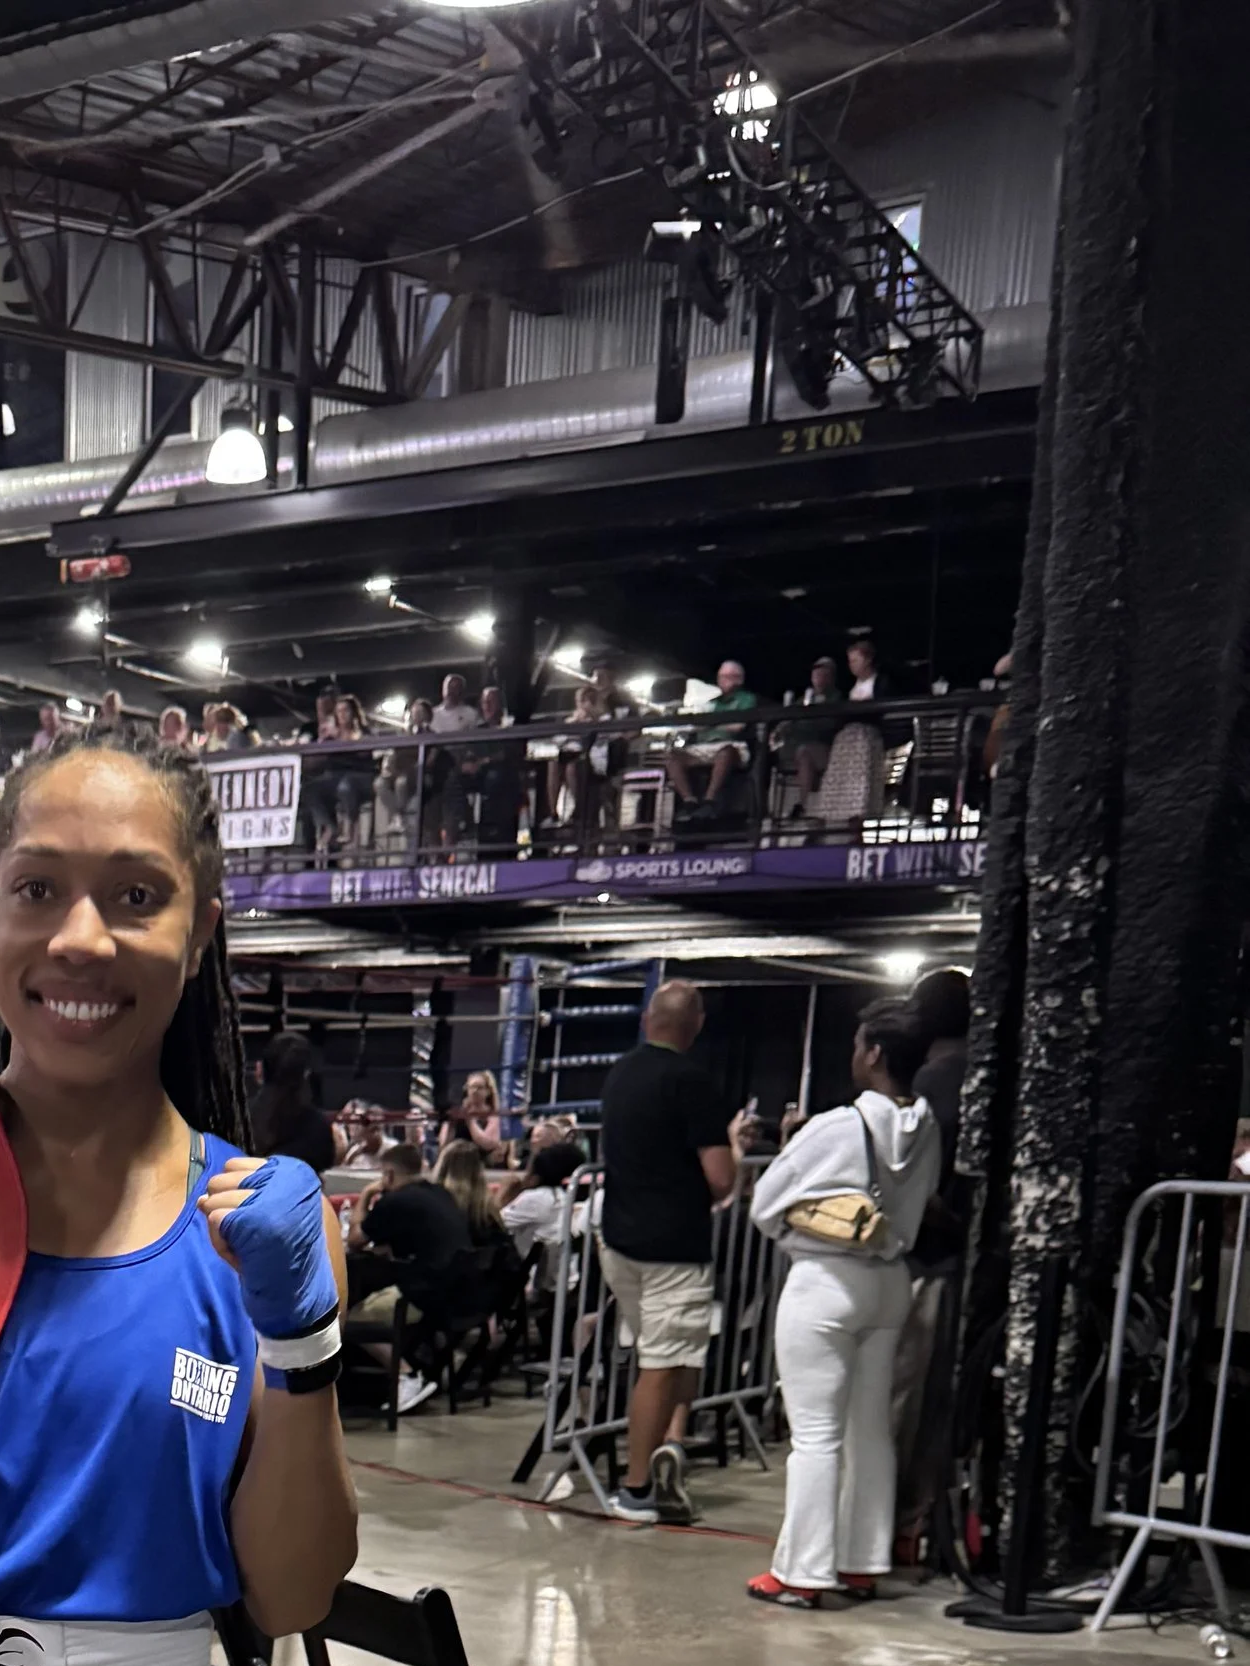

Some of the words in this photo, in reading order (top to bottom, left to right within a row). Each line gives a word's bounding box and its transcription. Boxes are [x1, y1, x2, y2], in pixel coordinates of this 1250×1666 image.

[780, 430, 798, 453] 2
[803, 418, 866, 451] TON
[227, 816, 291, 840] IGNS
[614, 858, 680, 879] SPORTS
[683, 856, 748, 876] LOUNG
[847, 847, 889, 880] BET
[331, 872, 364, 904] BET
[419, 863, 497, 900] SENECA!
[171, 1376, 232, 1417] ONTARIO
